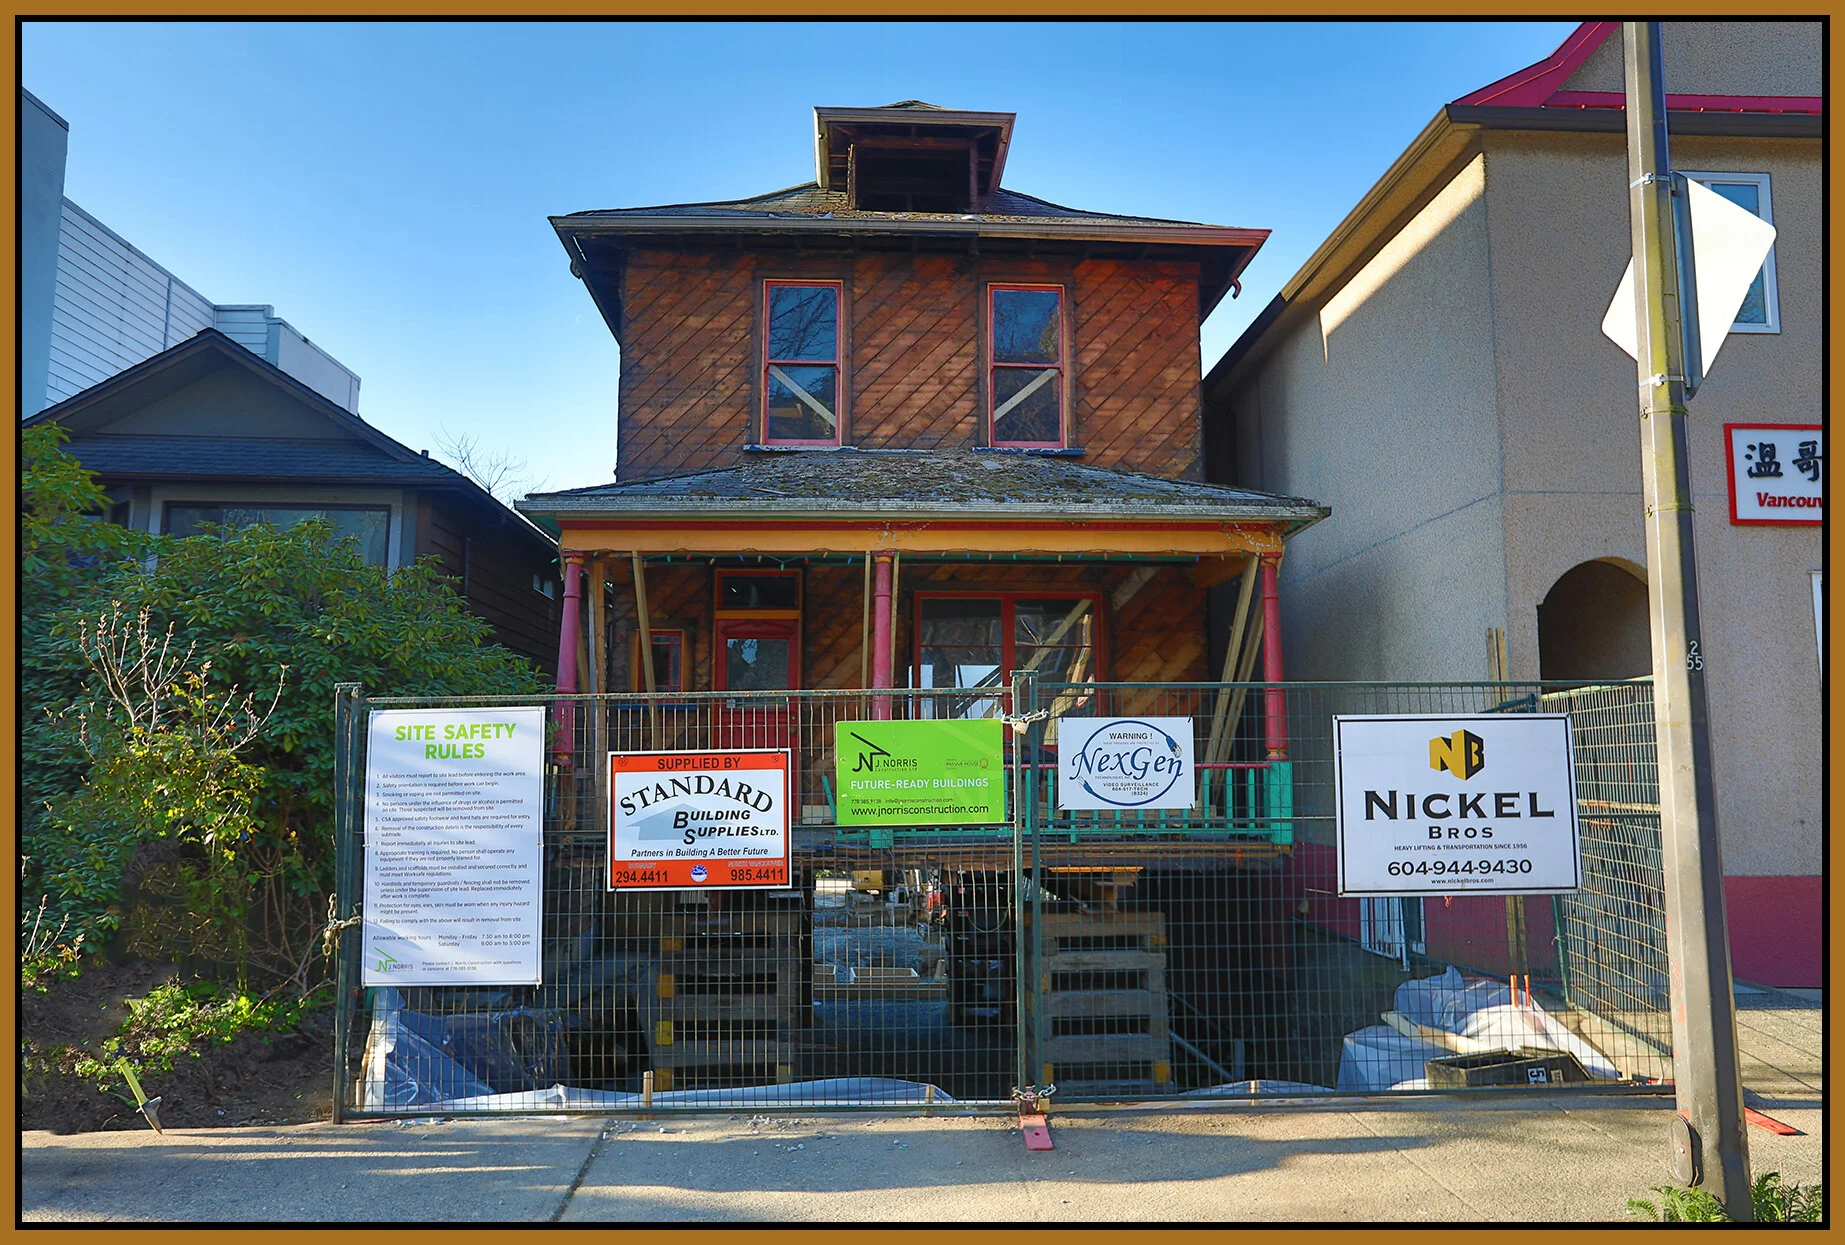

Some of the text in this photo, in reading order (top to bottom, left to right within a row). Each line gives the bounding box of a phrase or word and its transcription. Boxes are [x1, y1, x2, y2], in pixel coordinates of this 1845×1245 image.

[1690, 640, 1698, 655] 2
[395, 723, 516, 740] SITE SAFETY
[425, 743, 485, 759] RULES
[658, 758, 740, 770] SUPPLIED BY
[883, 759, 918, 767] NORRIS
[1069, 747, 1183, 780] NexGen
[851, 778, 989, 790] FUTURE-READY BUILDINGS
[620, 776, 773, 816] STANDARD
[851, 804, 989, 817] www.jnorrisconstruction.com
[1364, 790, 1555, 820] NICKEL
[673, 810, 750, 828] BUILDING
[683, 826, 758, 845] SUPPLIES
[1428, 826, 1494, 839] BROS
[676, 849, 708, 858] Building
[616, 868, 783, 882] 294.4411 985.4411
[1388, 860, 1532, 875] 604-944-9430
